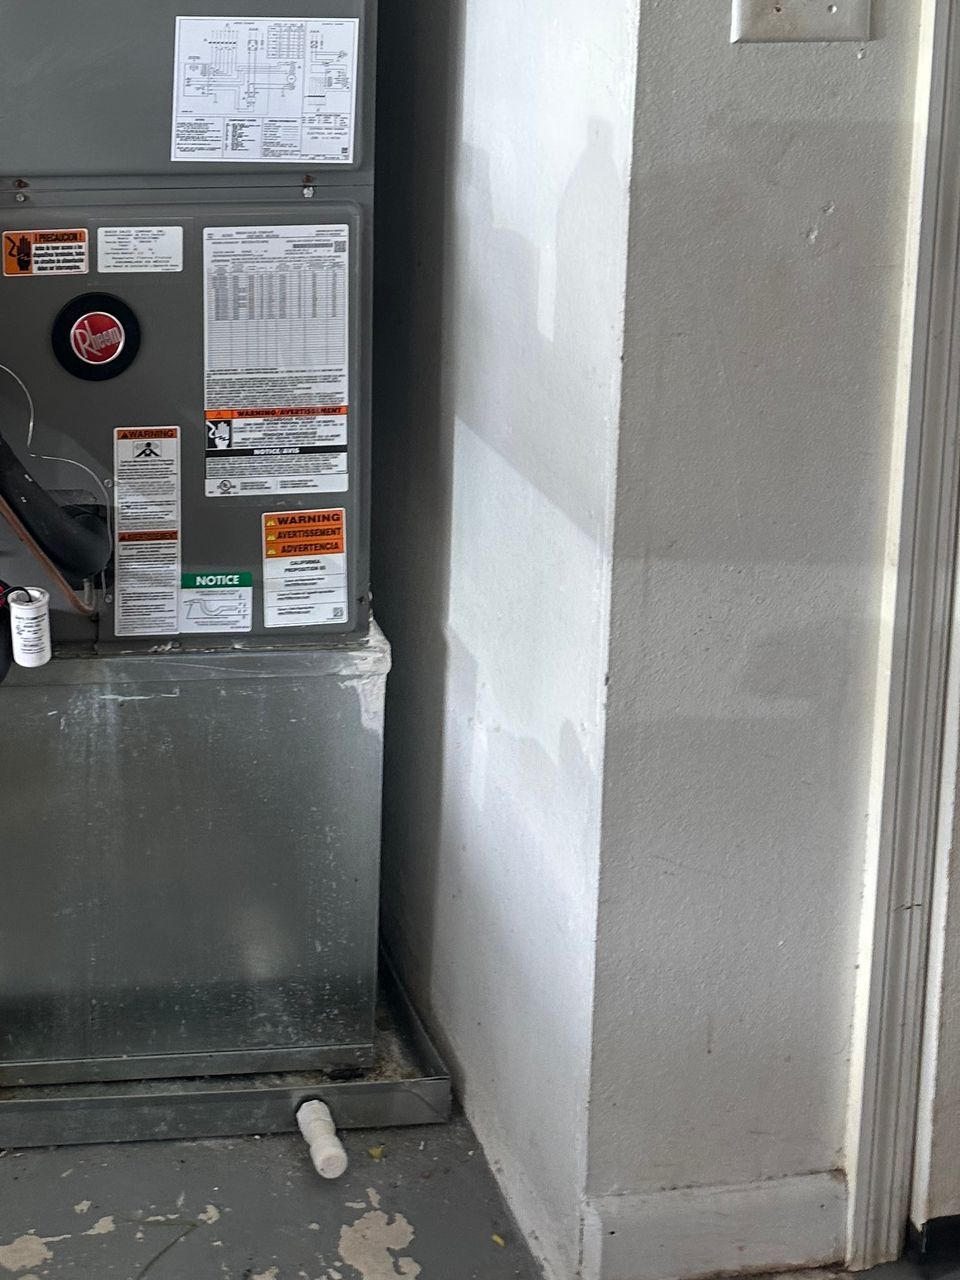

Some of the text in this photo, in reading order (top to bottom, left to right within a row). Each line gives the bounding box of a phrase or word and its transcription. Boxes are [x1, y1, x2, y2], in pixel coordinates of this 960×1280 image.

[74, 320, 121, 358] Rheem
[277, 513, 341, 525] WARNING
[276, 527, 341, 540] AVERTISSEMENT
[281, 542, 340, 554] ADVERTENCIA
[195, 575, 240, 586] NOTICE
